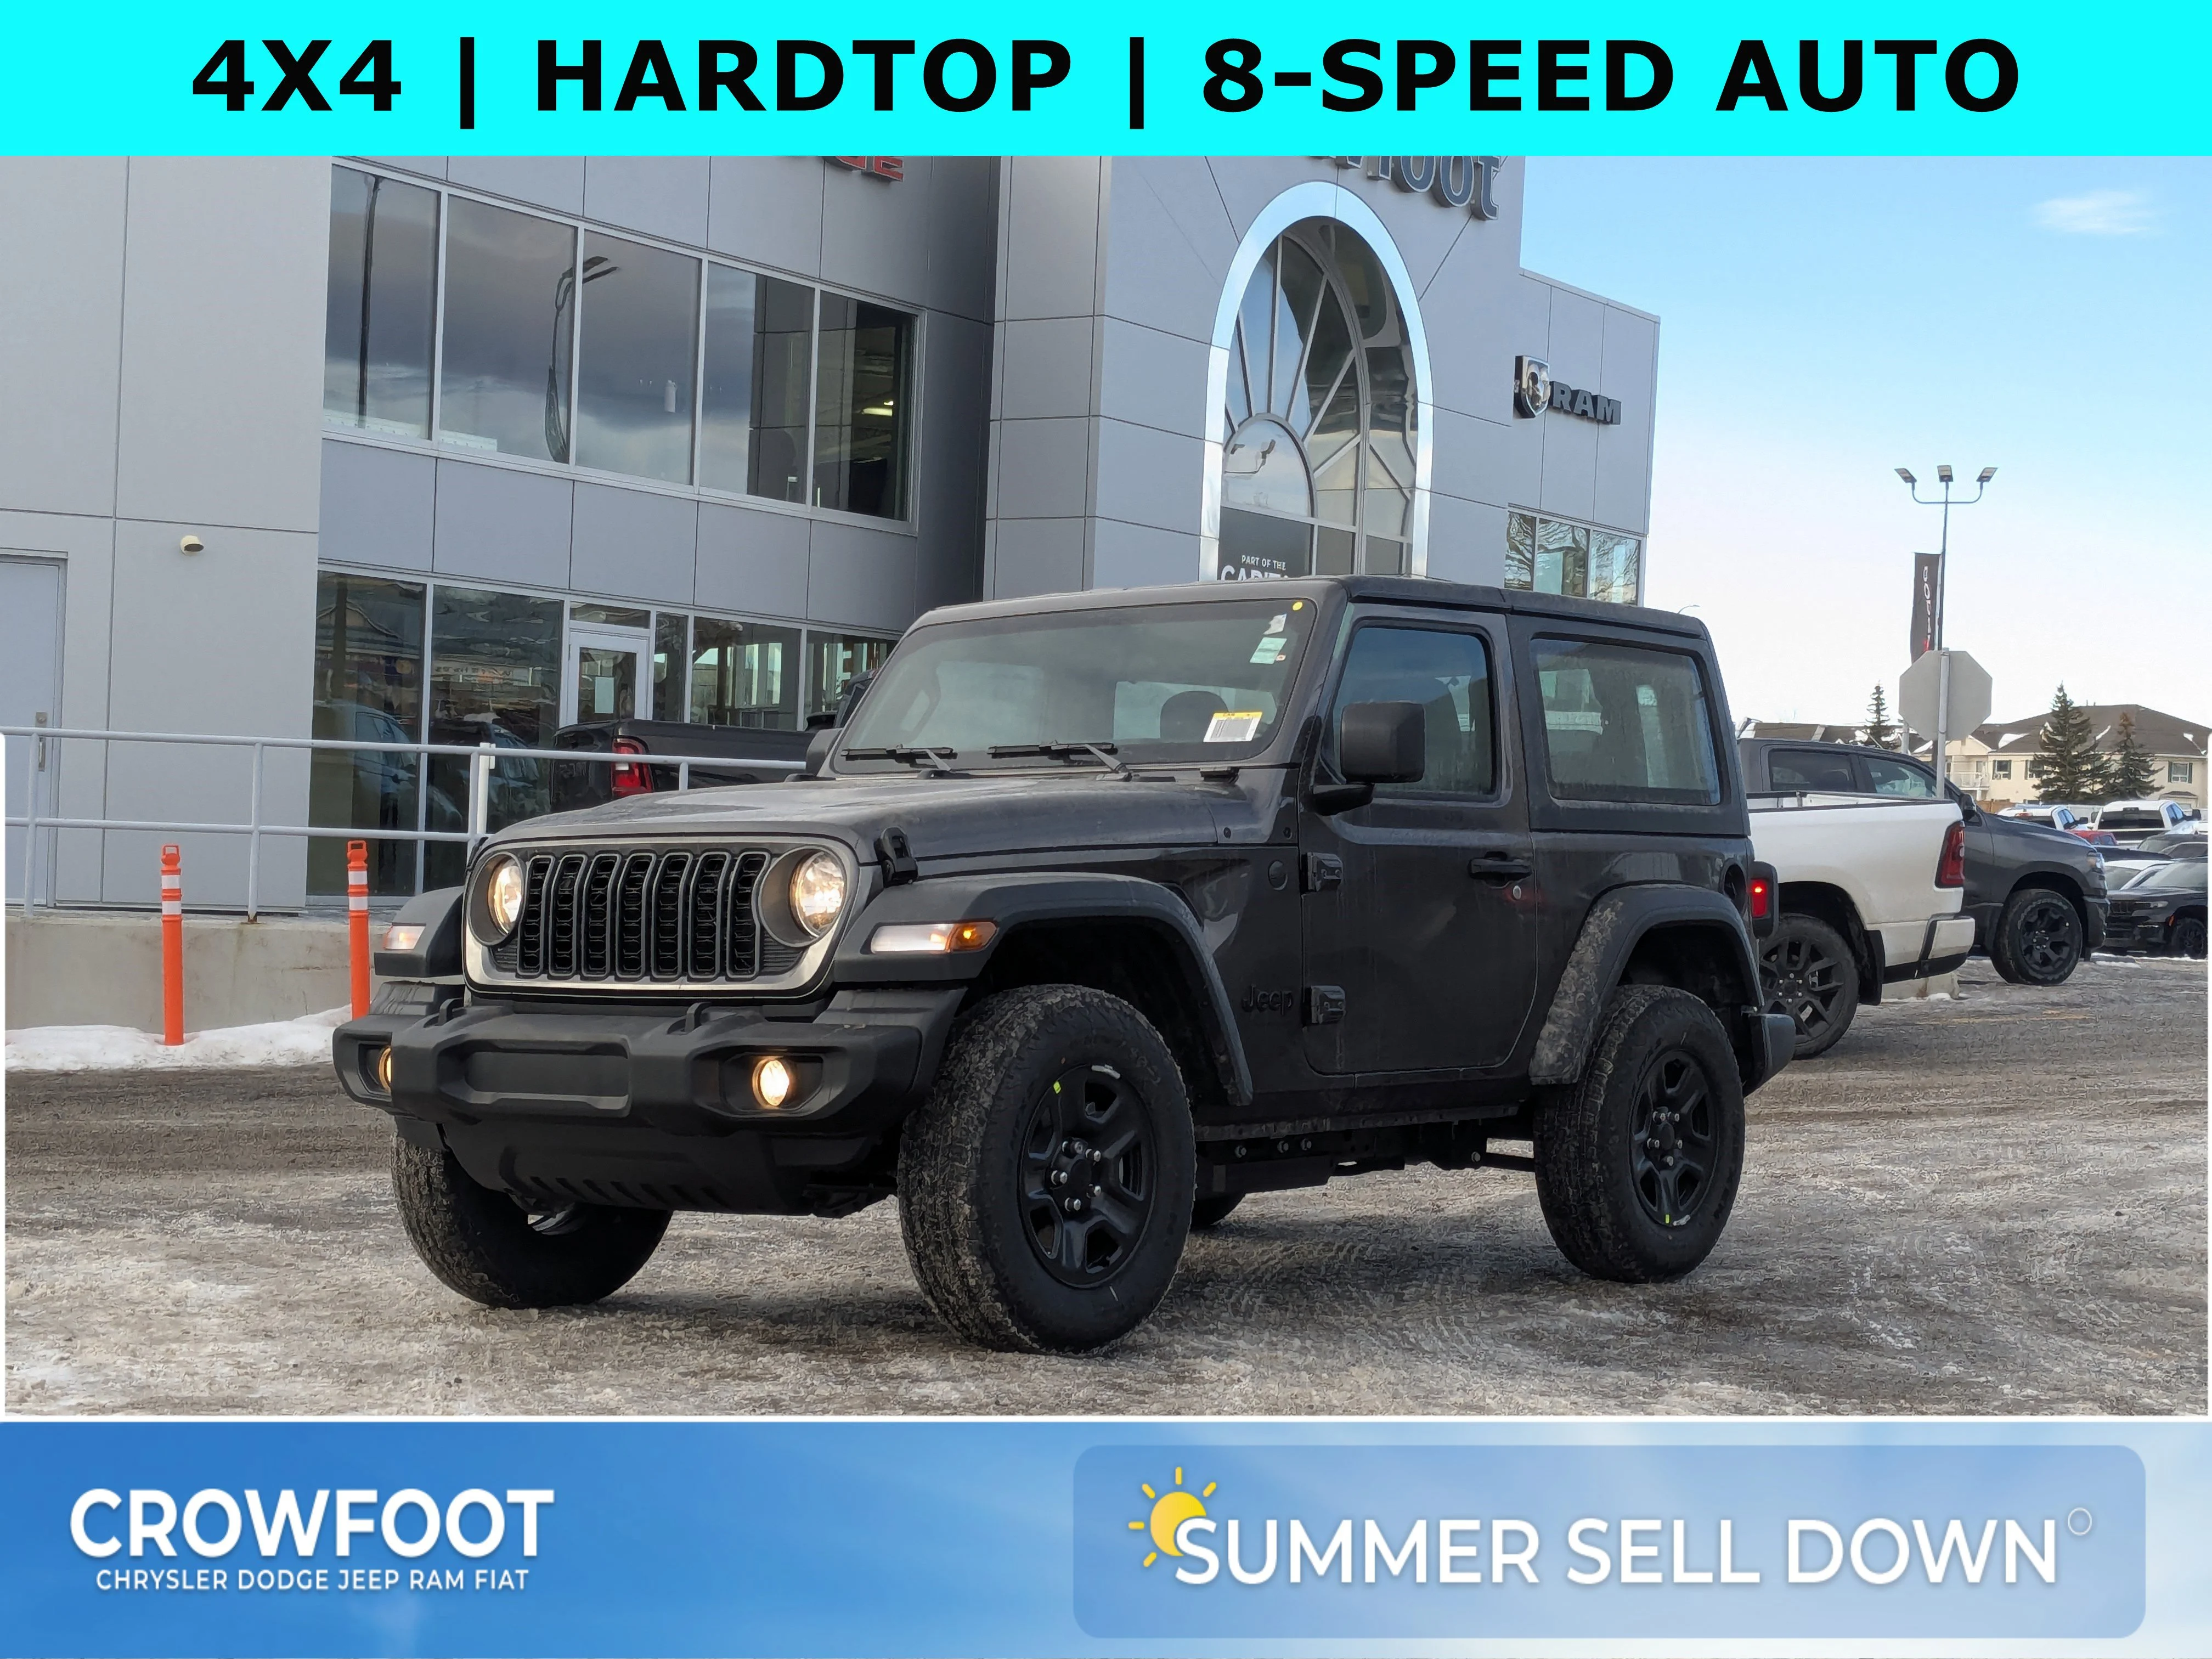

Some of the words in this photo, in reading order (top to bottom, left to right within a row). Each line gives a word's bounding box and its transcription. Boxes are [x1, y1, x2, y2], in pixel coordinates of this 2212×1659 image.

[1551, 380, 1622, 425] RAM
[1242, 555, 1260, 567] PART
[1261, 558, 1271, 568] OF
[1241, 984, 1294, 1015] Jeep
